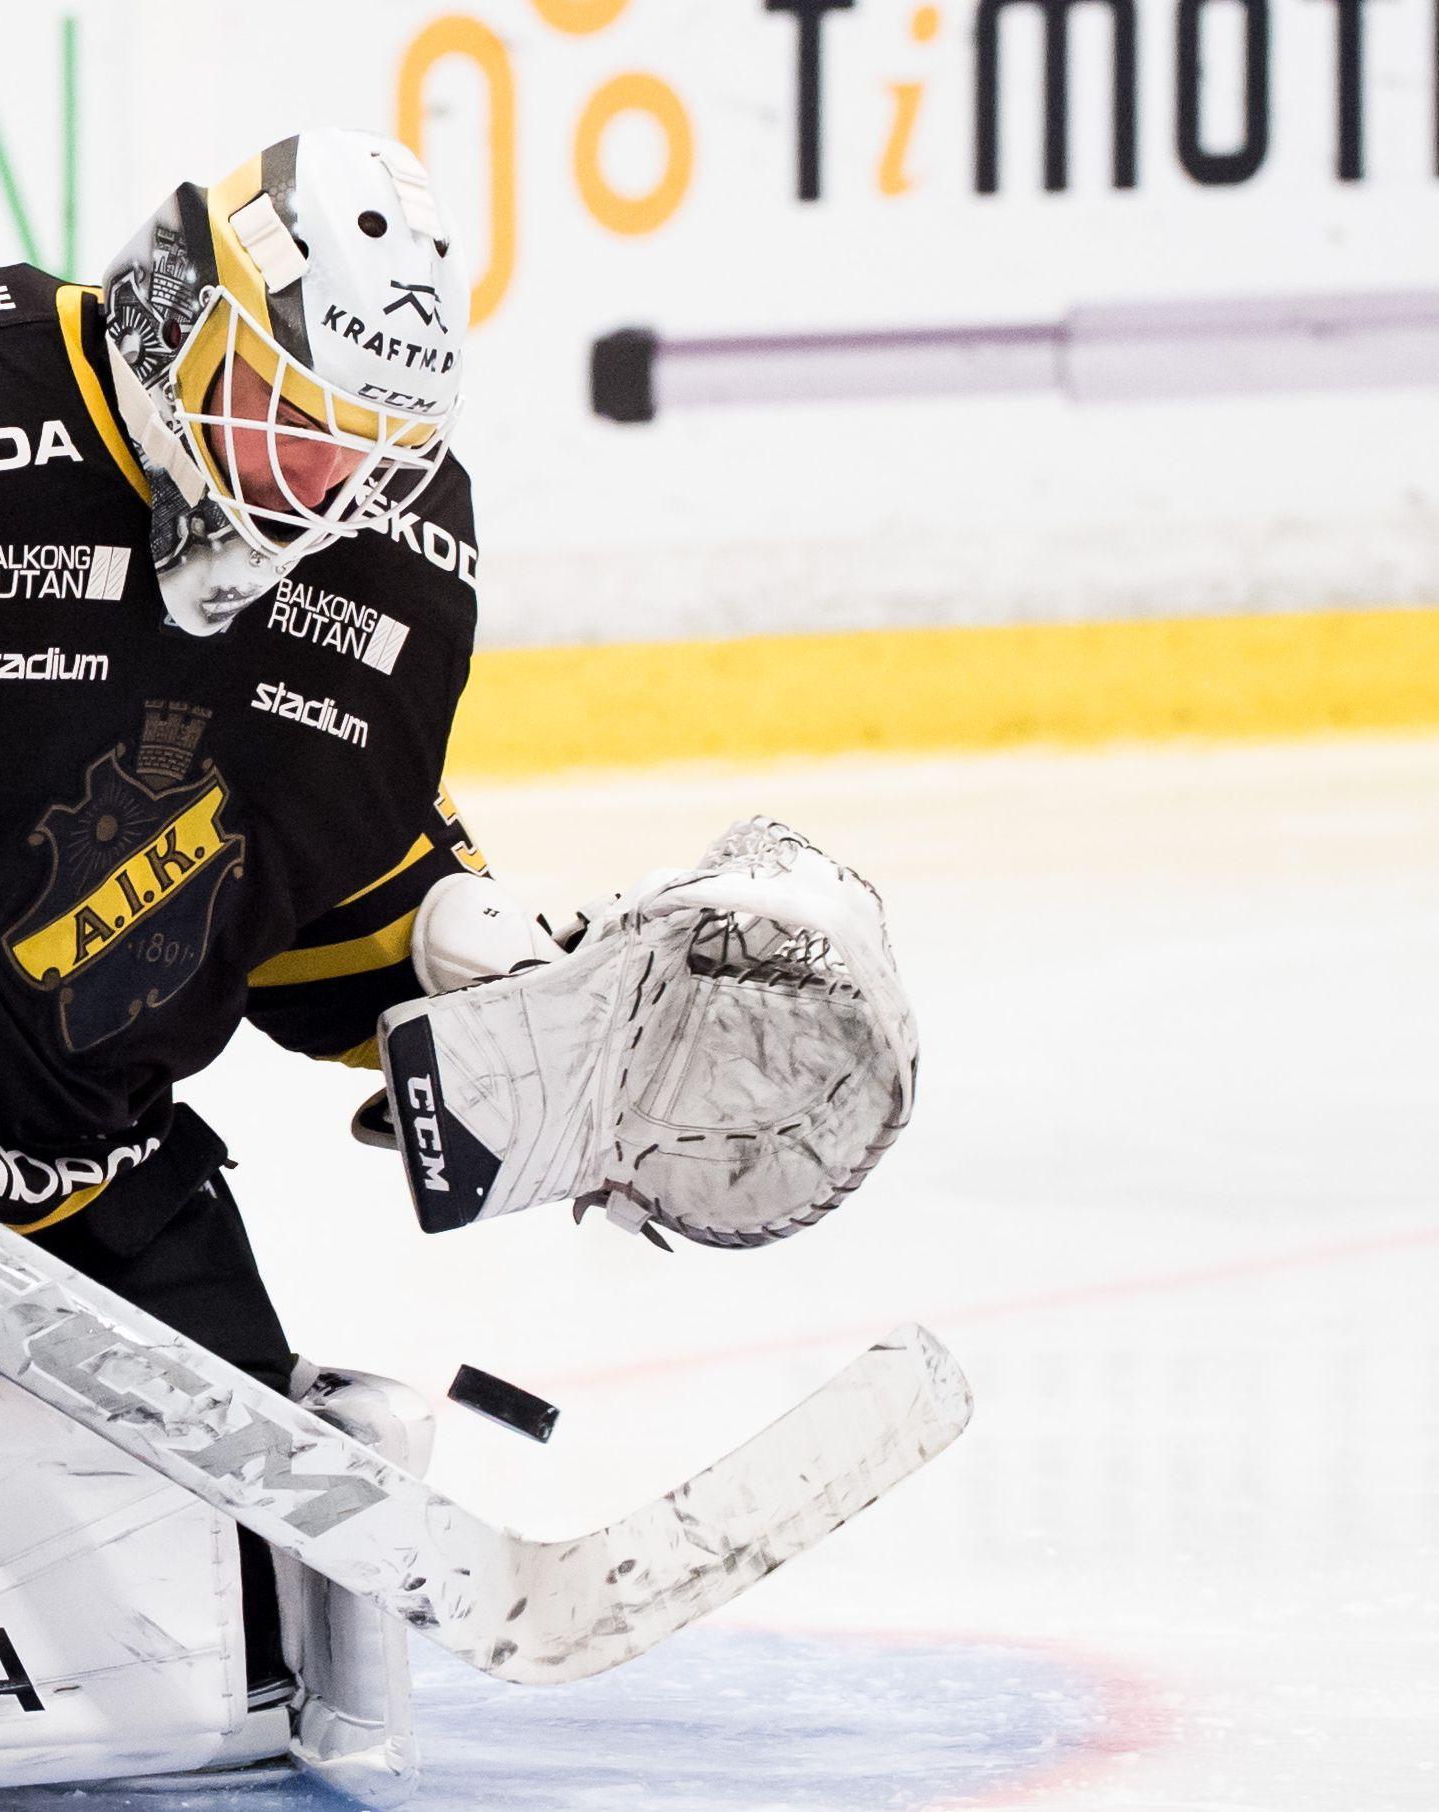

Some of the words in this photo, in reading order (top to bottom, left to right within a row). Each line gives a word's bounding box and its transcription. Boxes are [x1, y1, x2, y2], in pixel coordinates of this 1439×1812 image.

[768, 0, 1439, 202] TiMOT
[357, 383, 438, 413] CCM
[267, 601, 367, 660] RUTAN
[276, 578, 378, 632] BALKONG
[251, 682, 369, 748] stadium
[73, 826, 206, 966] A.I.K.
[406, 1074, 450, 1192] CCM
